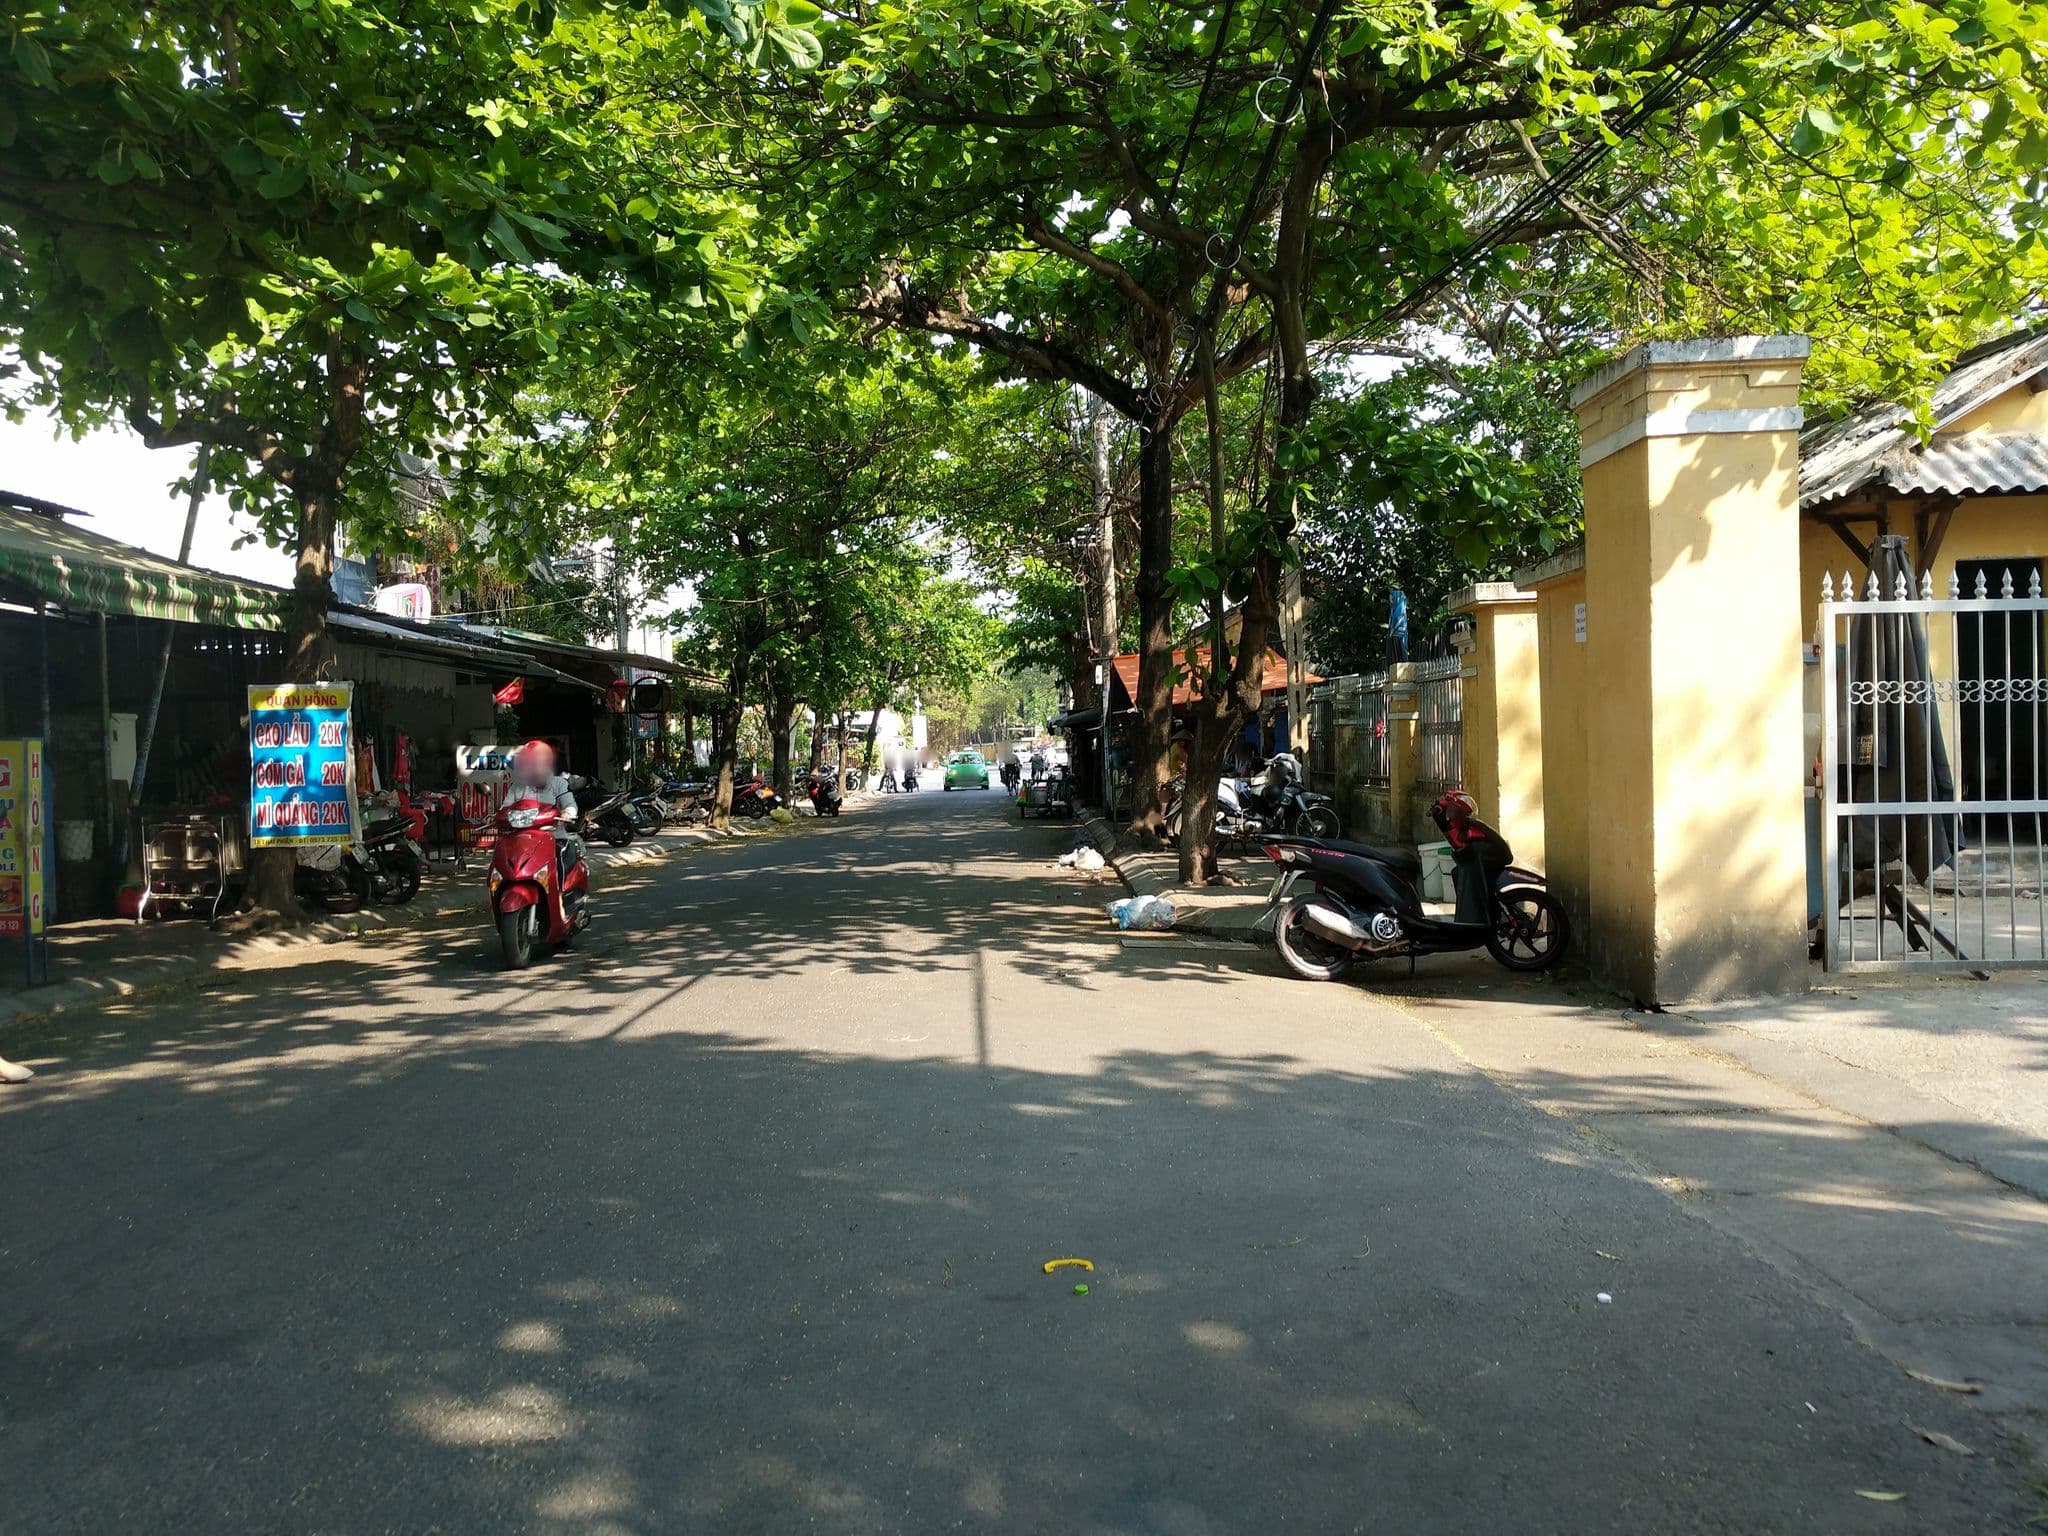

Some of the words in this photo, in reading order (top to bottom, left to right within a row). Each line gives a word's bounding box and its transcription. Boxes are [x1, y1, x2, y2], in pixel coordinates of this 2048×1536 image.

[255, 722, 282, 748] CAO
[319, 722, 344, 747] 20K
[256, 759, 284, 787] CƠM
[322, 761, 346, 786] 20K
[322, 801, 348, 826] 20K
